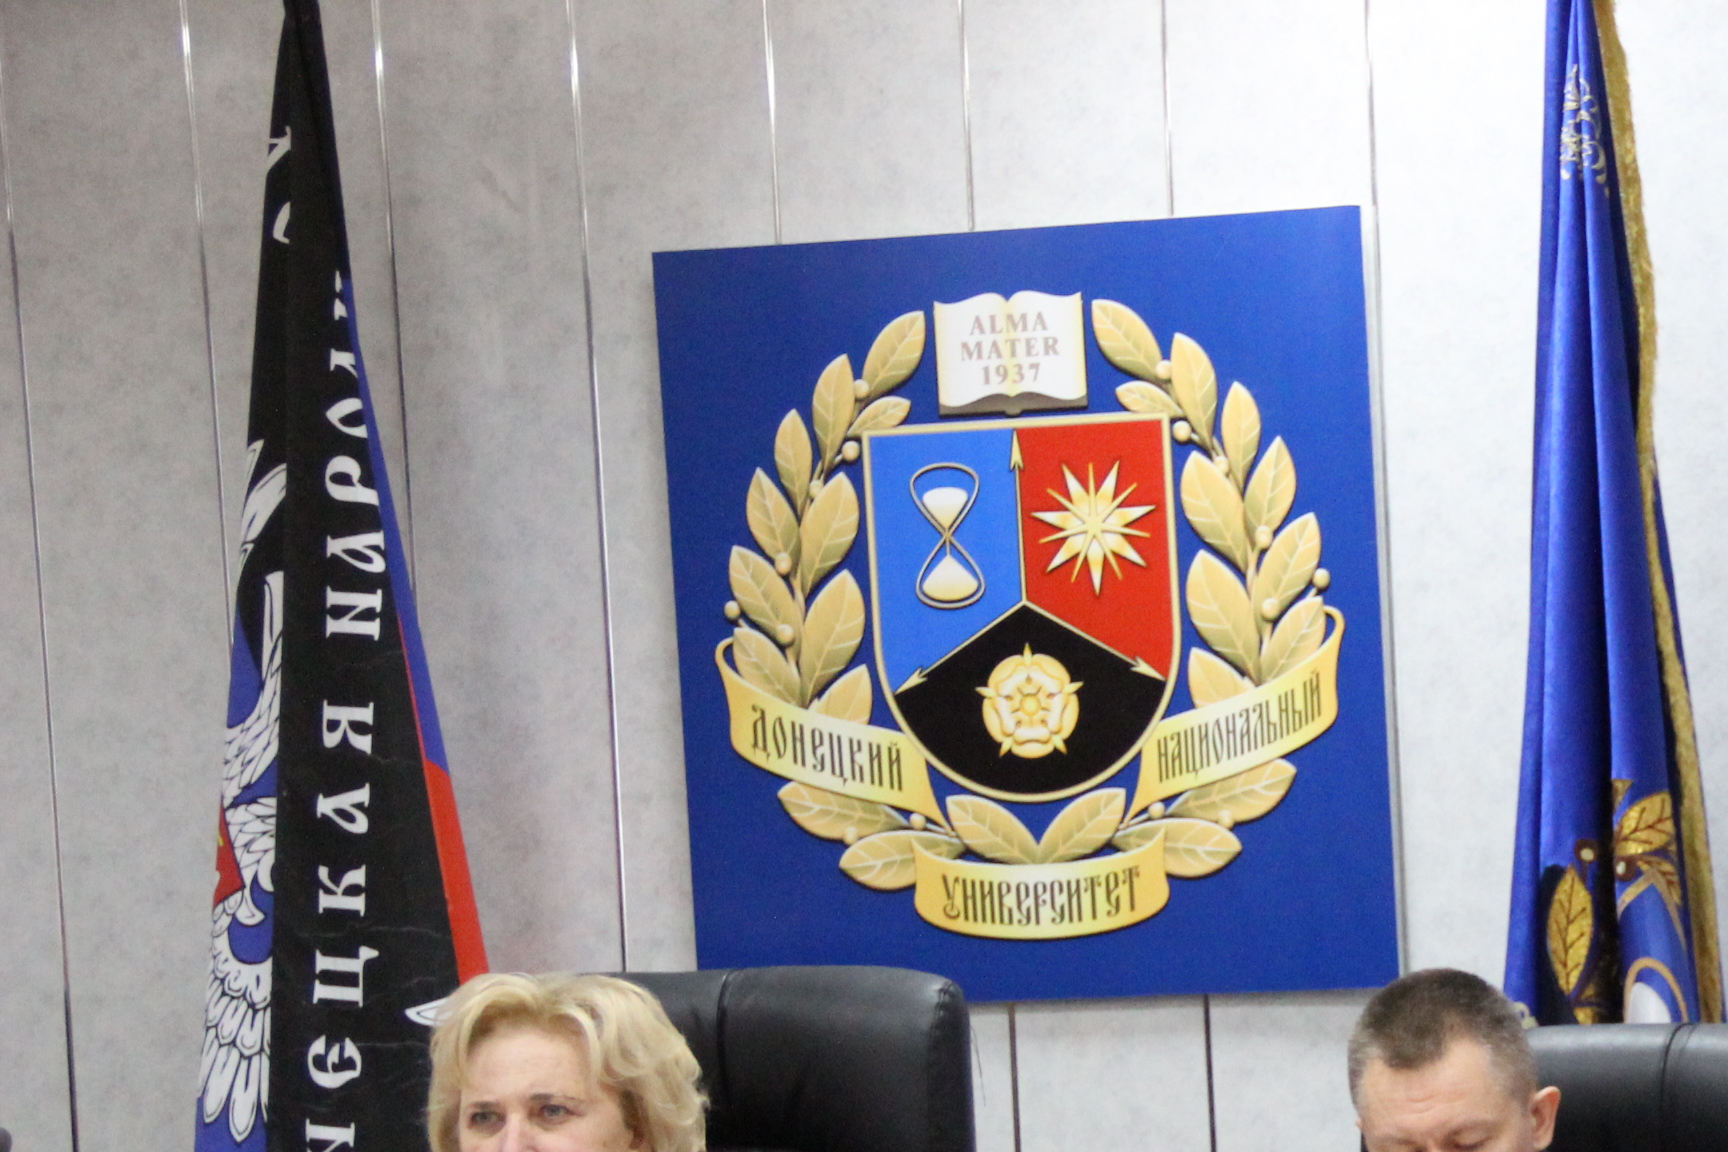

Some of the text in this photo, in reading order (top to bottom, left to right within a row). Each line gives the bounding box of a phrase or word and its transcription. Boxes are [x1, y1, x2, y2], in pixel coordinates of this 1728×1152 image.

[969, 311, 1048, 336] ALMA
[961, 336, 1060, 362] MATER
[981, 362, 1041, 385] 1937
